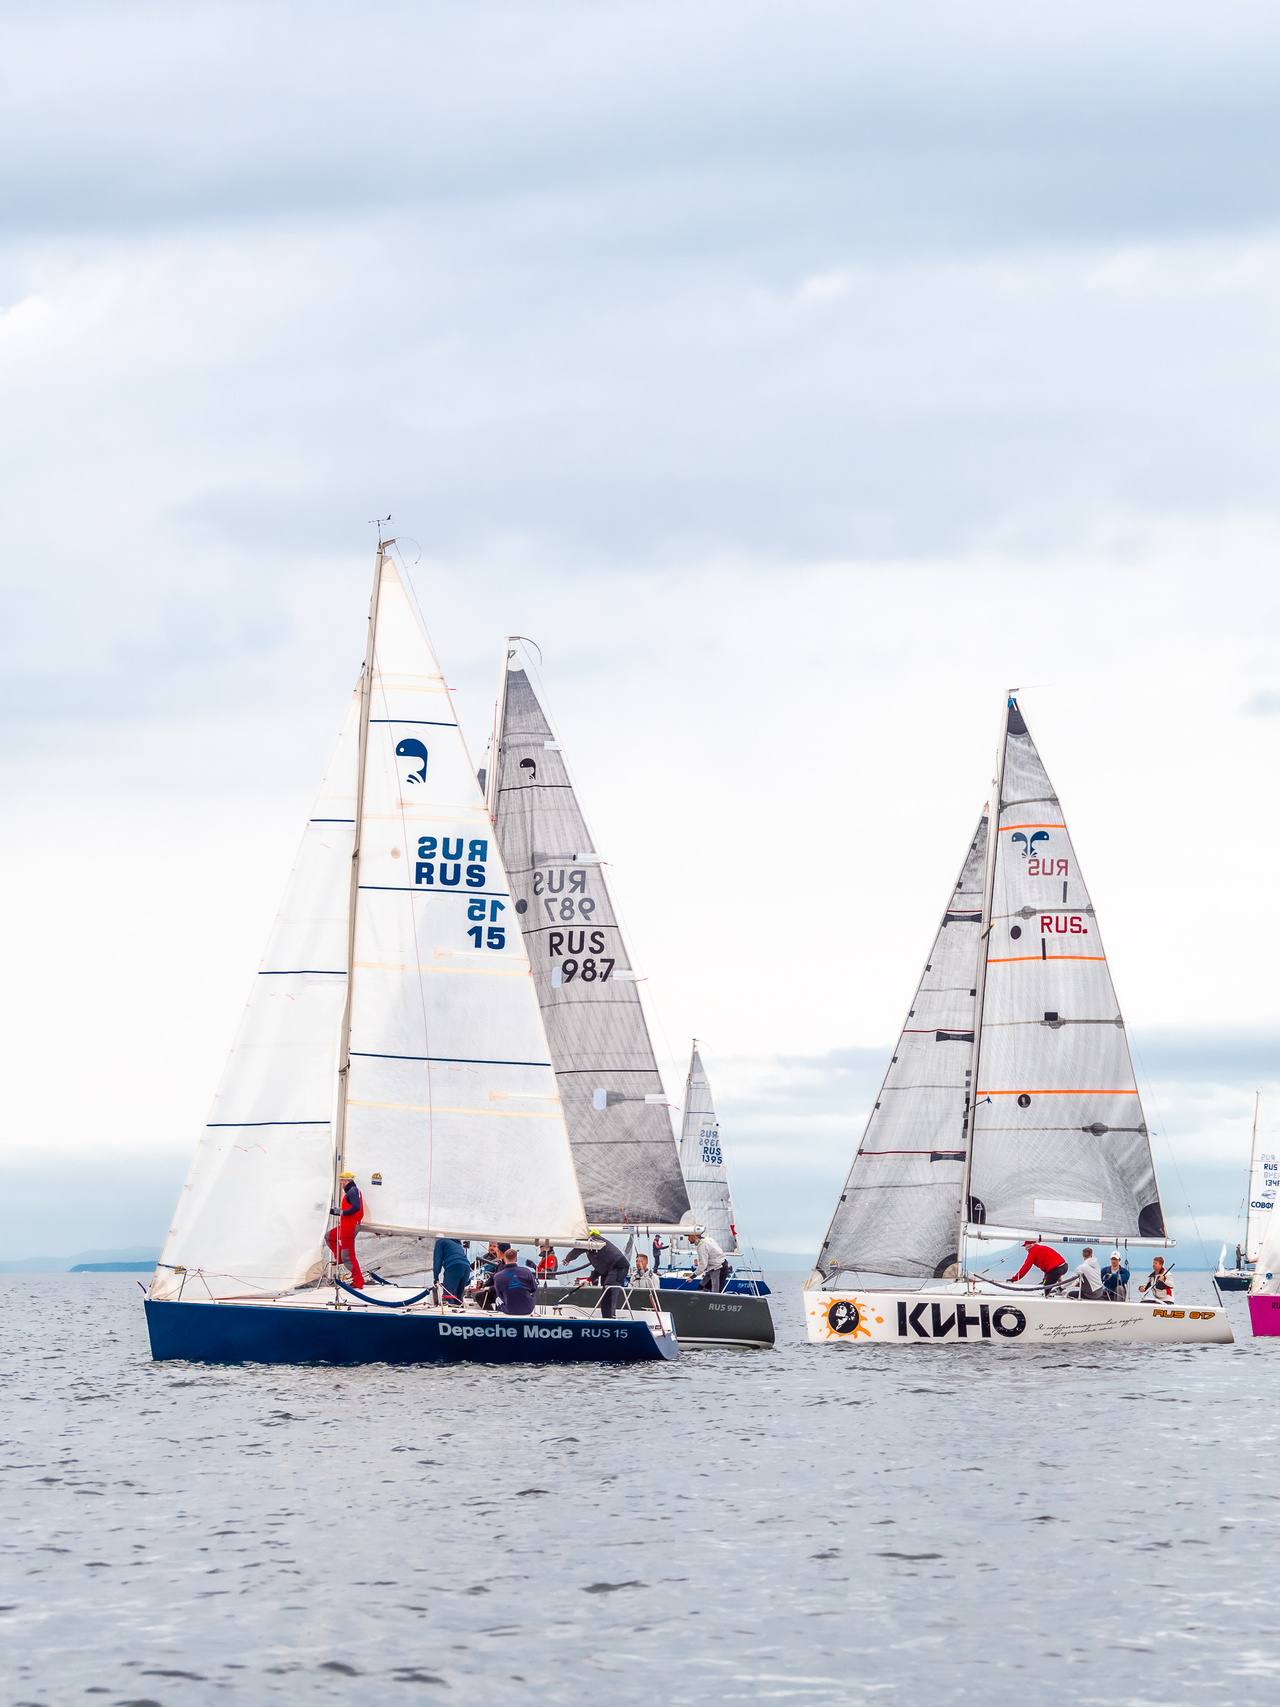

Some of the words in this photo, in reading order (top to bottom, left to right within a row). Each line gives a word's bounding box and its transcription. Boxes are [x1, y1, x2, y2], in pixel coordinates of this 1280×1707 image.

[415, 862, 486, 887] RUS
[467, 926, 506, 950] 15
[549, 931, 605, 957] RUS
[561, 958, 615, 983] 987
[702, 1154, 723, 1164] 1395
[703, 1146, 721, 1156] RUS
[1263, 1163, 1278, 1171] RUS
[708, 1303, 726, 1312] RUS
[727, 1304, 742, 1312] 987
[1153, 1309, 1185, 1319] RUS
[1189, 1311, 1216, 1320] 817
[897, 1301, 1027, 1338] КИНО
[438, 1322, 518, 1339] Depeche
[523, 1325, 573, 1339] Mode
[581, 1328, 610, 1338] RUS
[613, 1329, 628, 1339] 15
